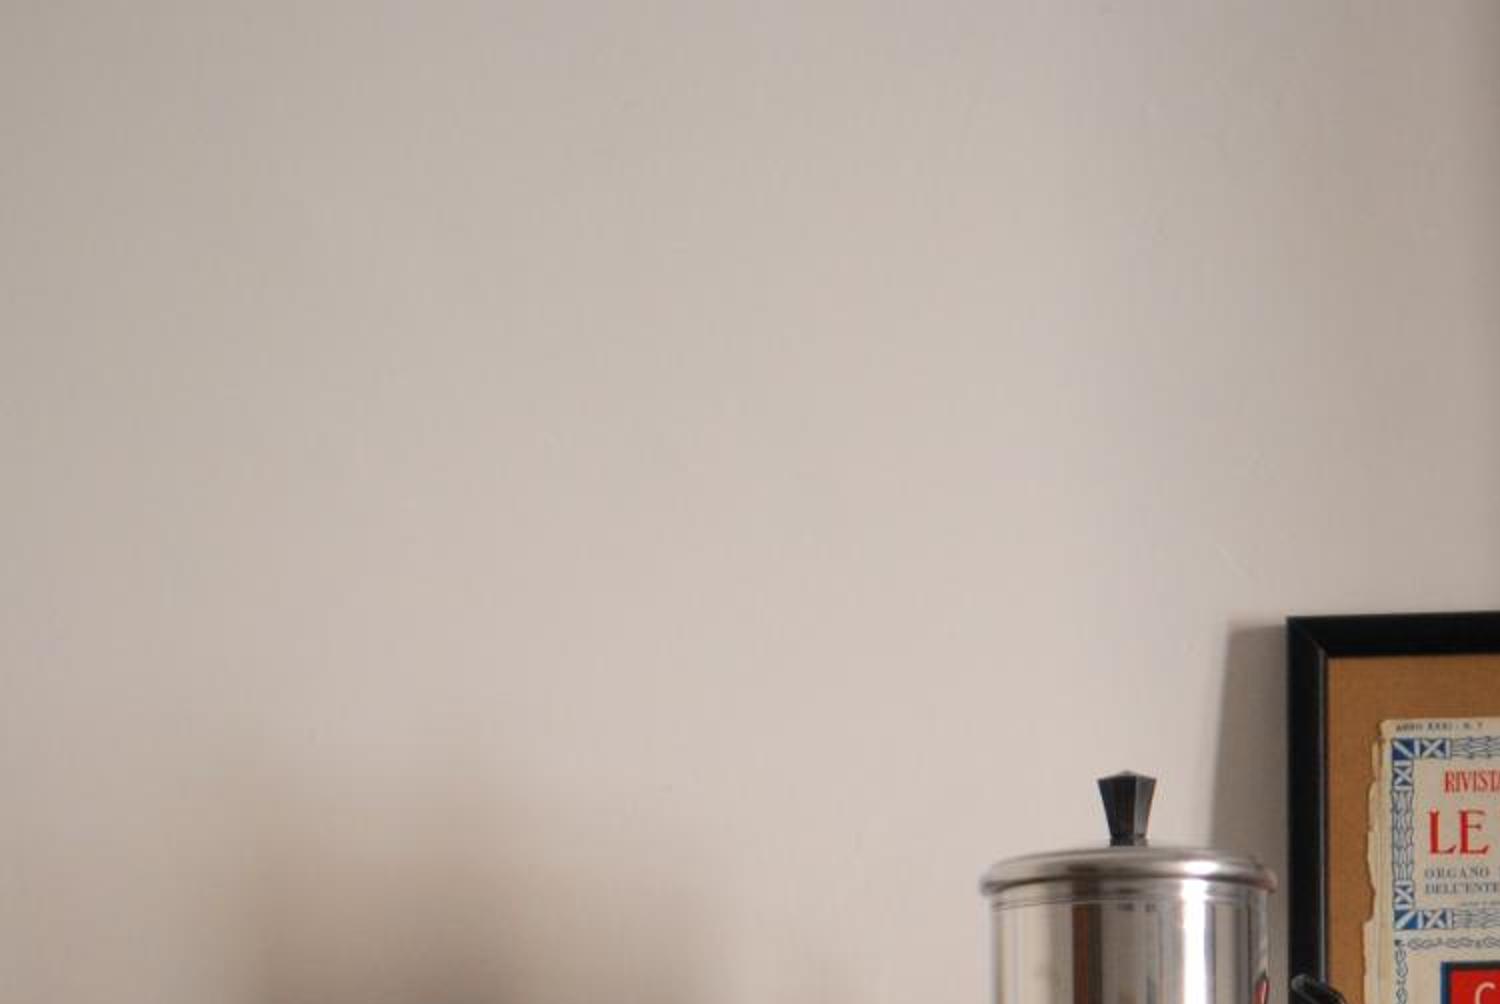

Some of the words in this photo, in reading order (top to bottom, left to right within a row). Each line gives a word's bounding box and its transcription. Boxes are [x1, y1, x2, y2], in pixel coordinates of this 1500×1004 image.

[1426, 808, 1490, 855] LE
[1424, 865, 1490, 879] ORGANO
[1424, 880, 1499, 895] DELL'ENTE
